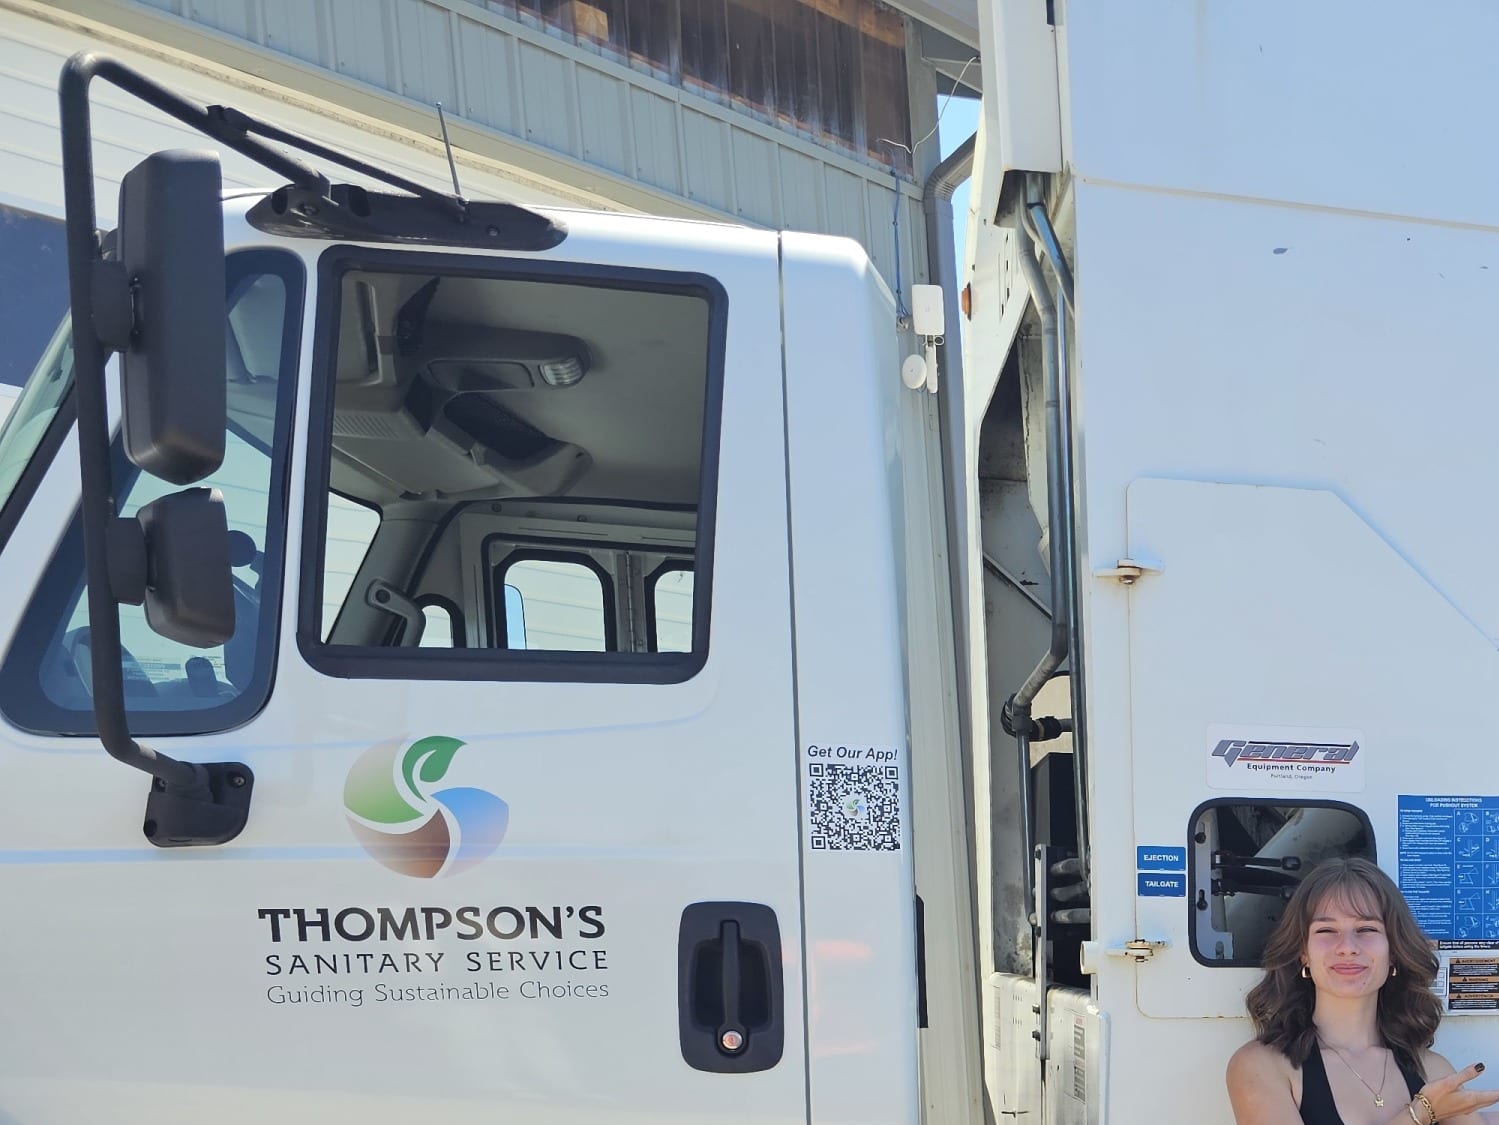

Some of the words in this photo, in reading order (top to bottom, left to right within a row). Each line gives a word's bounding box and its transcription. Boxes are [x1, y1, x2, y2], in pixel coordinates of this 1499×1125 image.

[807, 745, 833, 758] Get
[836, 746, 863, 759] Our
[865, 747, 898, 763] App!
[1212, 739, 1360, 768] General
[1247, 762, 1294, 772] Equipment
[1296, 764, 1336, 774] Company
[1143, 854, 1179, 862] EJECTION
[1145, 880, 1180, 888] TAILGATE
[257, 905, 606, 943] THOMPSON'S
[266, 952, 445, 976] SANITARY
[466, 950, 609, 972] SERVICE
[266, 984, 364, 1008] Guiding
[374, 981, 510, 1003] Sustainable
[519, 980, 609, 1000] Choices
